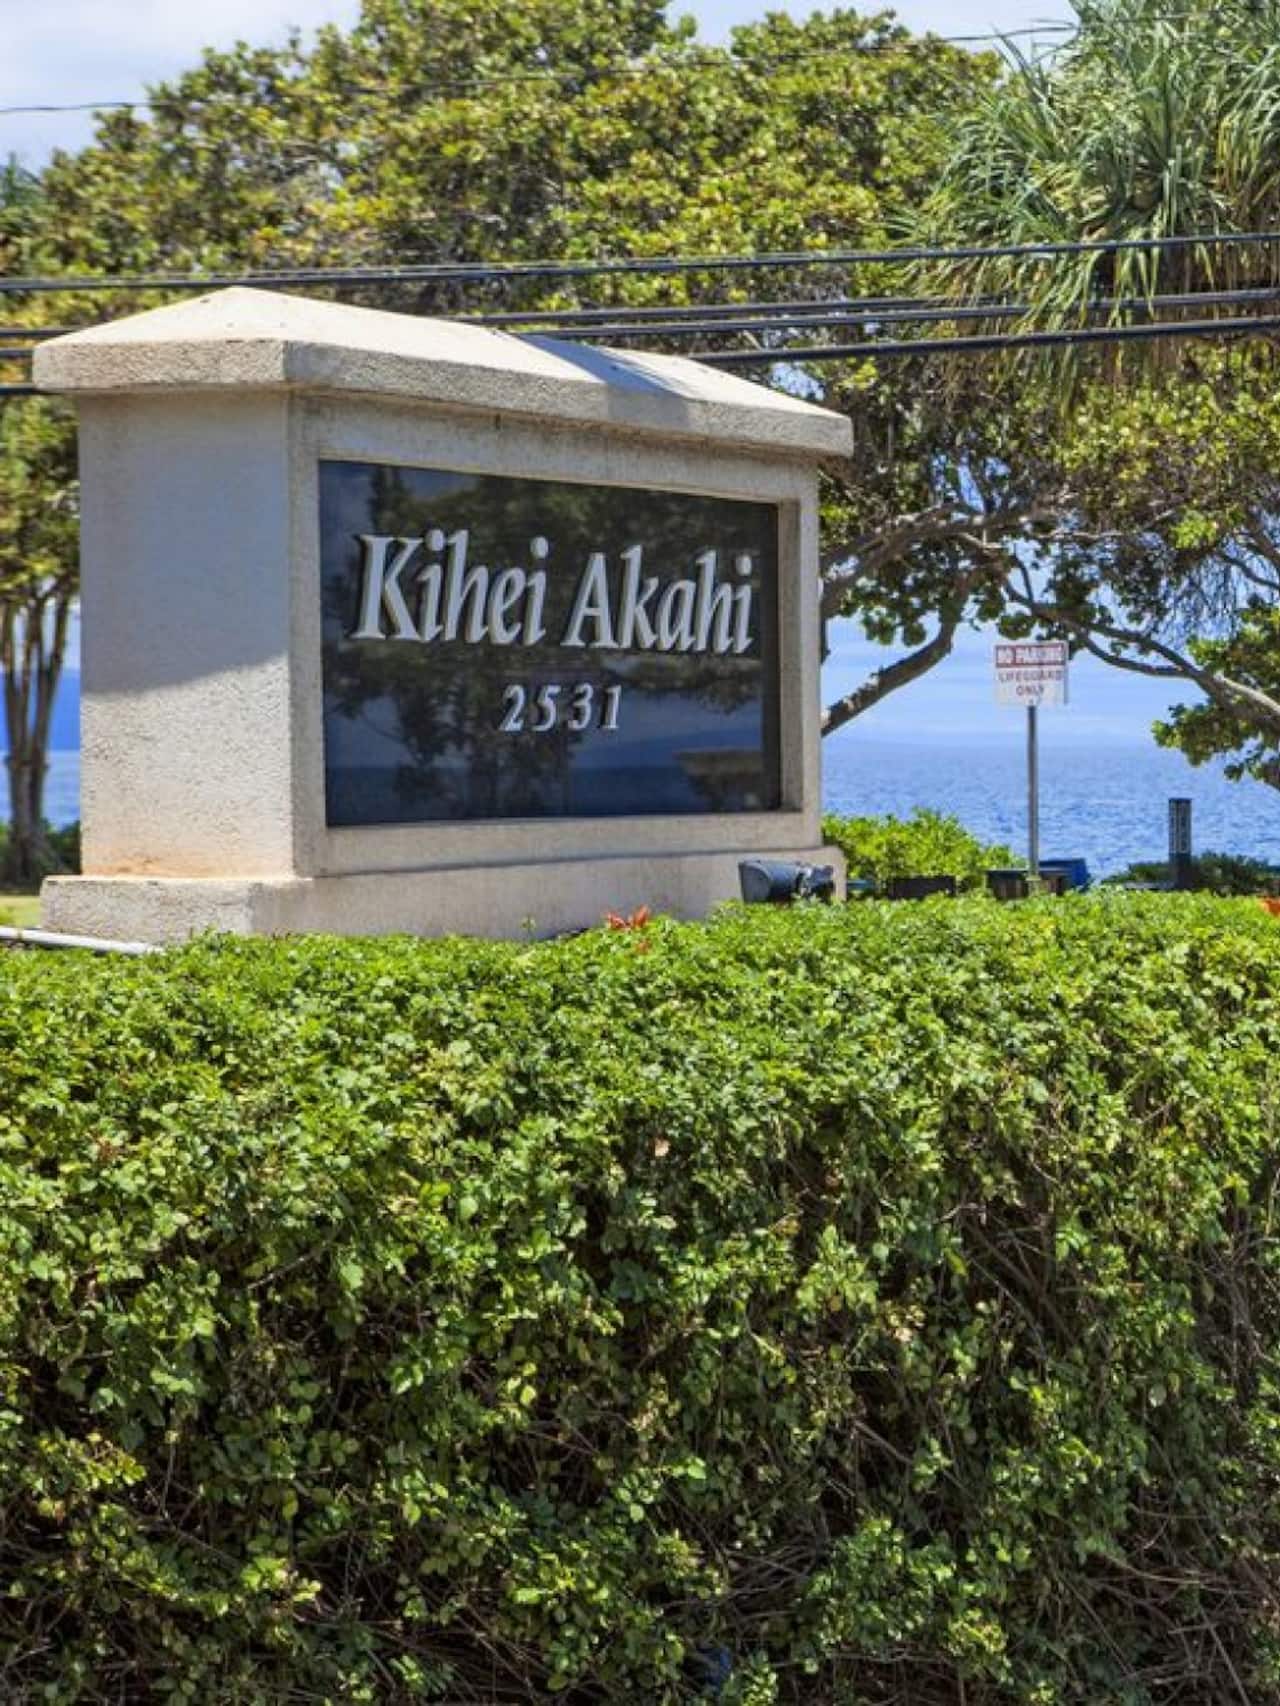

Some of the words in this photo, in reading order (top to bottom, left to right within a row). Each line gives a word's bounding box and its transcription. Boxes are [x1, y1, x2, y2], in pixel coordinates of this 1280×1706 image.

[349, 528, 550, 646] Kihei
[560, 543, 756, 655] Akahi
[500, 683, 623, 733] 2531
